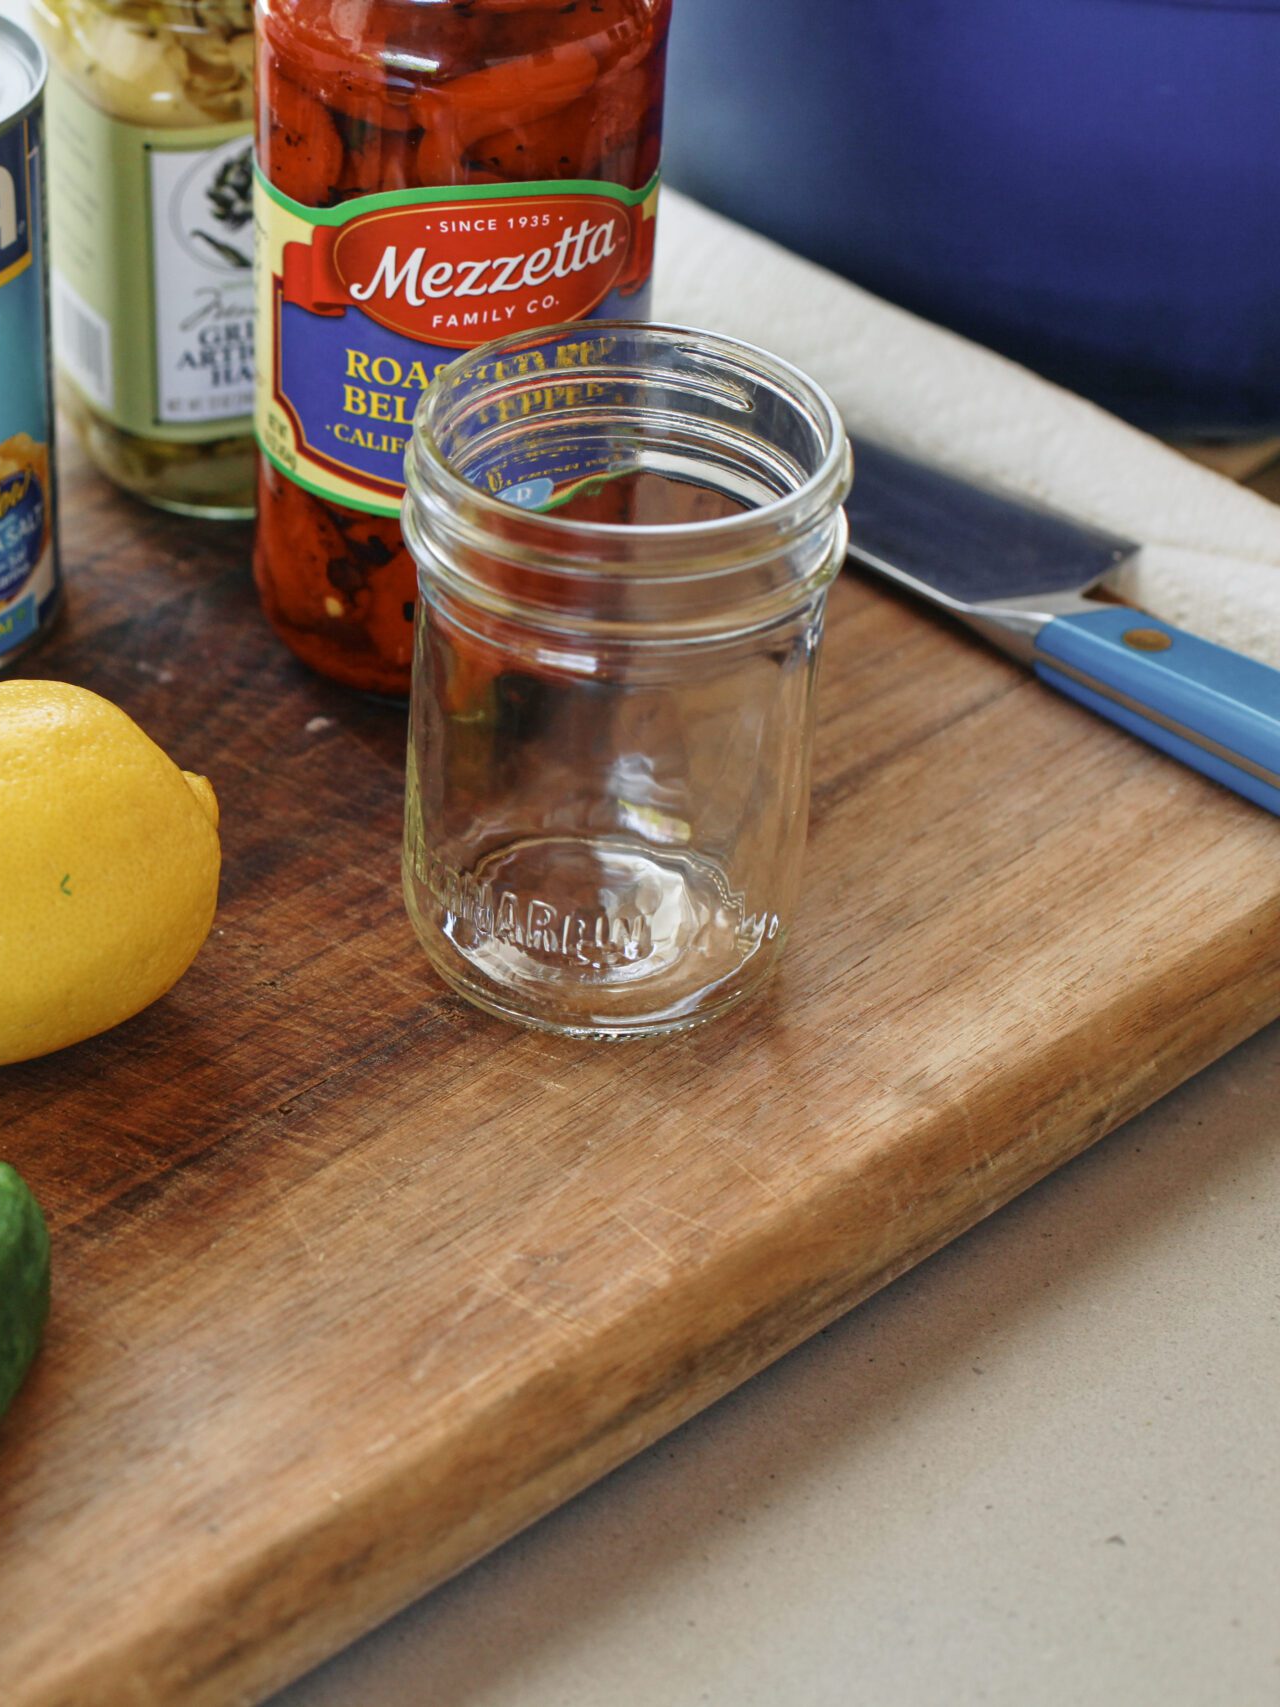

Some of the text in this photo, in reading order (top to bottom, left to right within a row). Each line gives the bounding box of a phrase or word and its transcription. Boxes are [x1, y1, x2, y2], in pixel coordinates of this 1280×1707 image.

[439, 214, 551, 233] SINCE 1935
[349, 218, 616, 306] Mezzetta
[432, 295, 560, 328] FAMILY CO.
